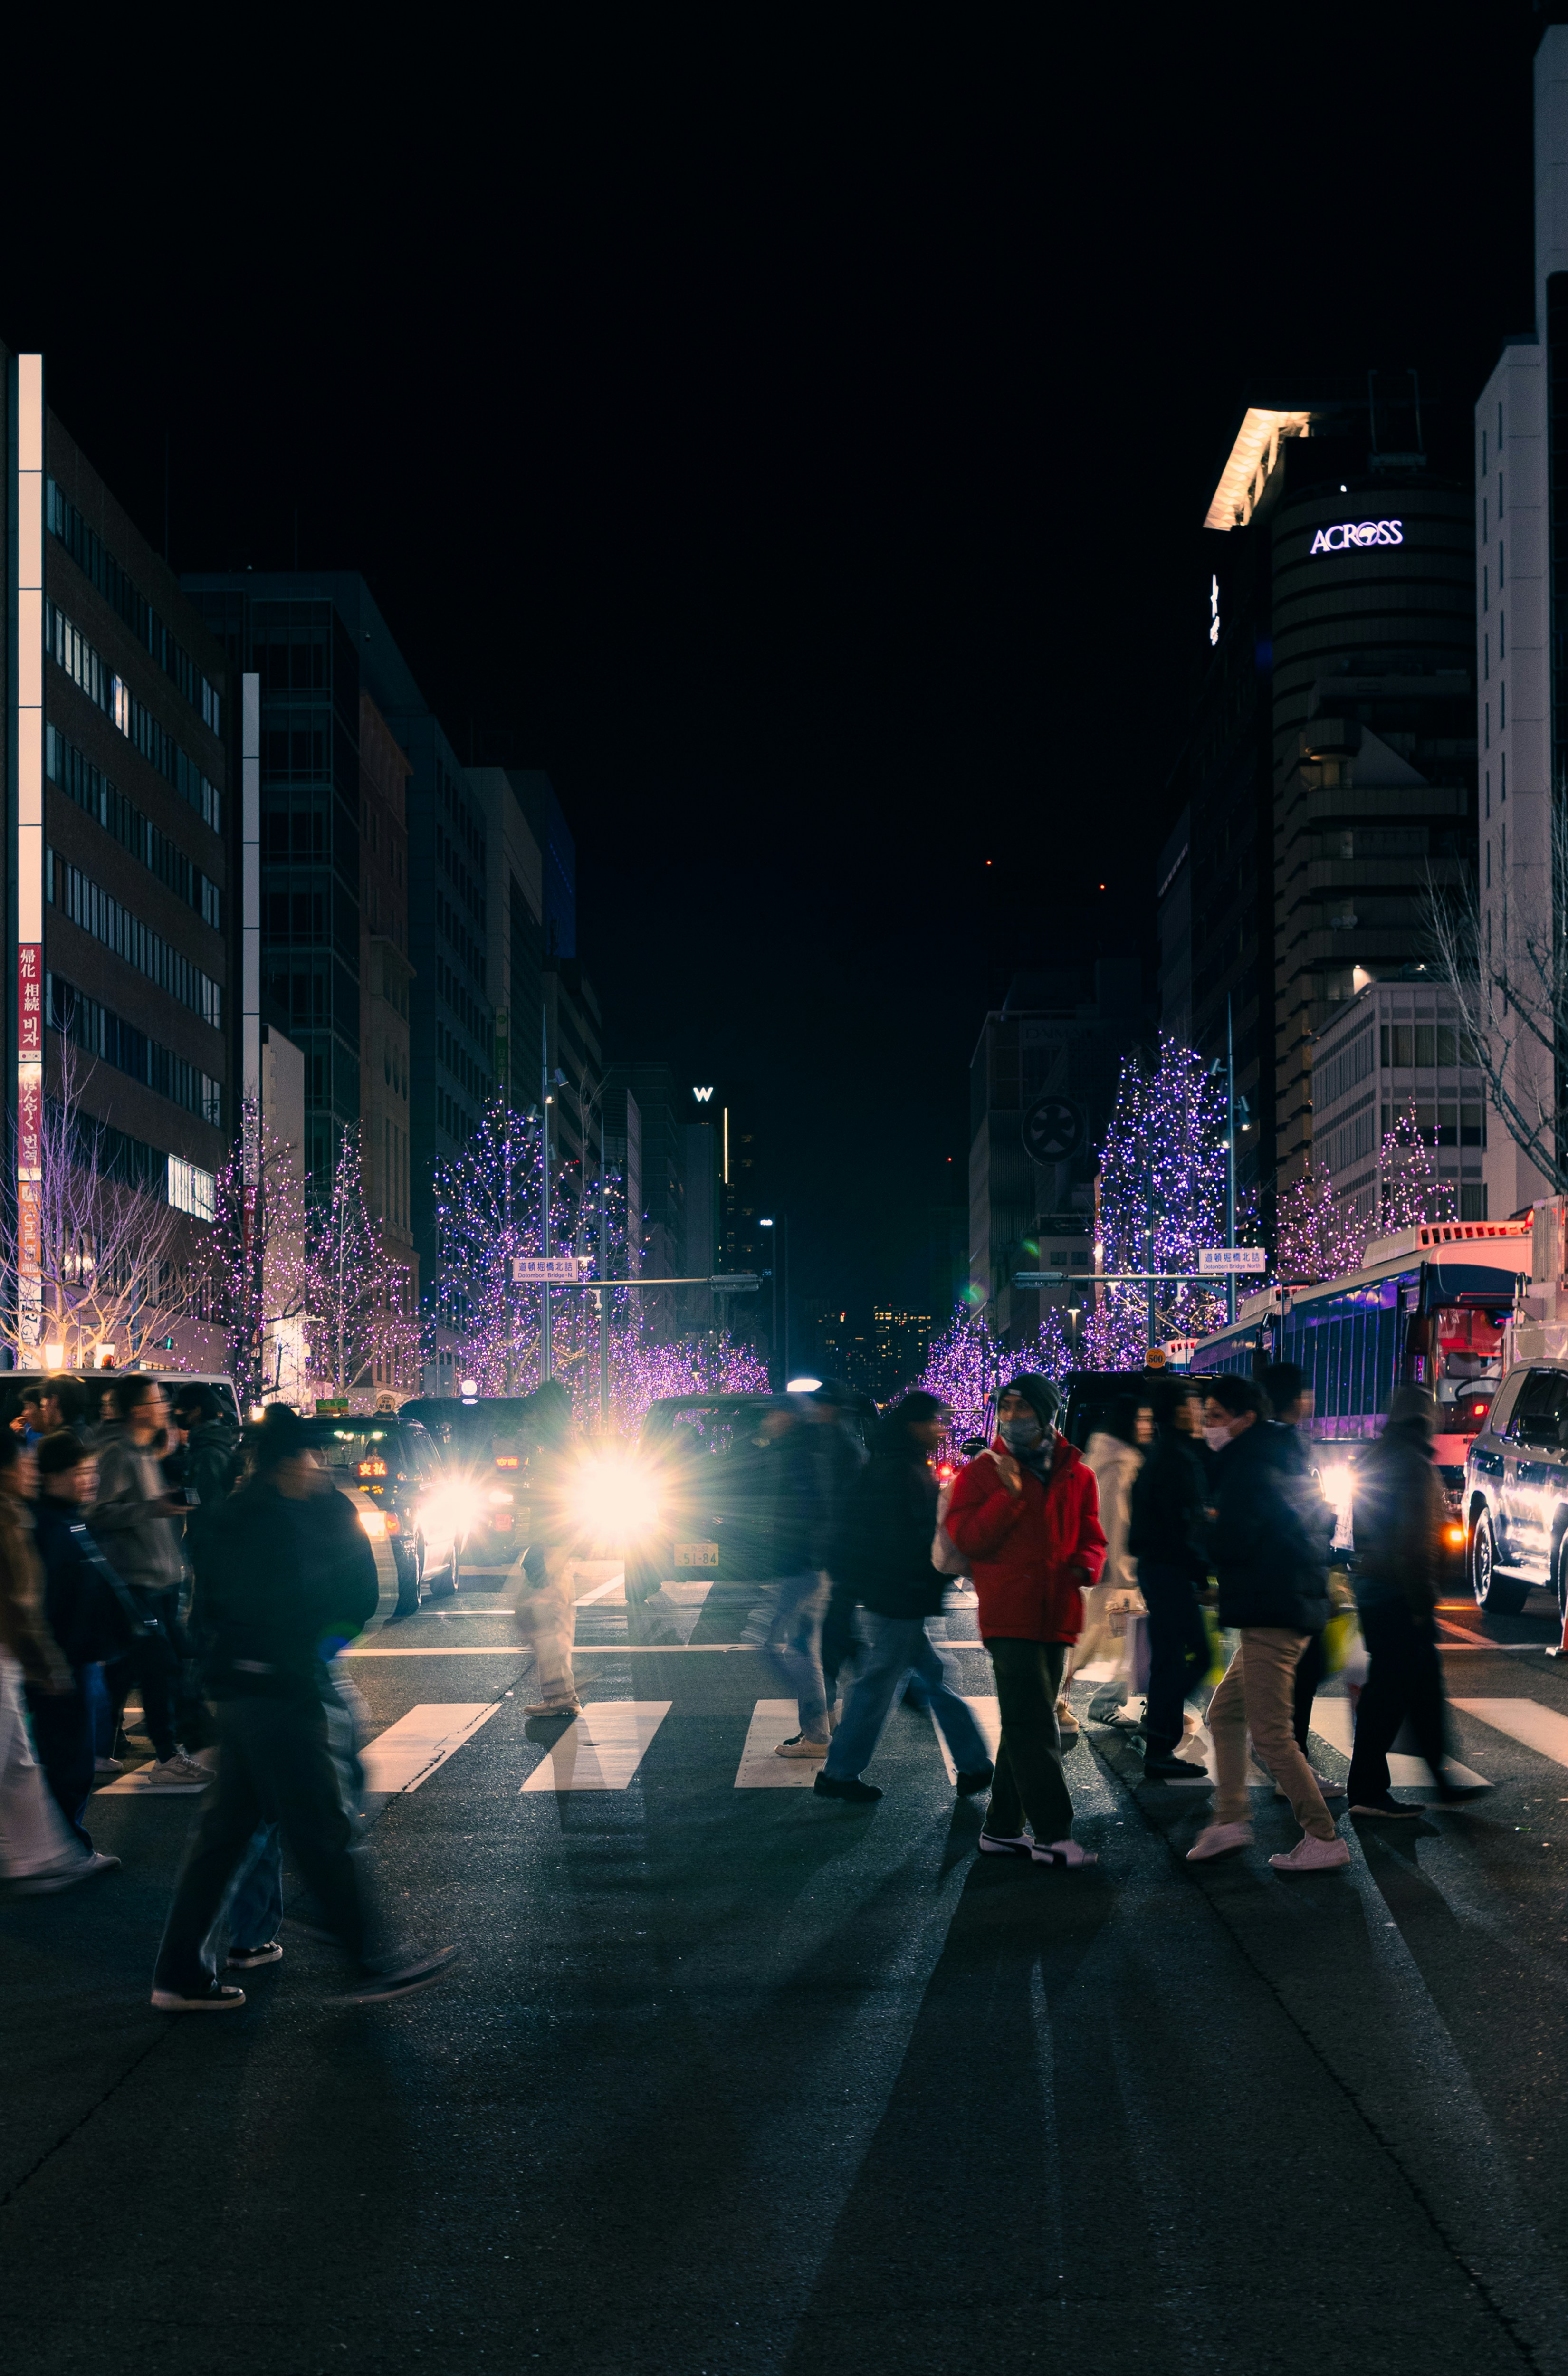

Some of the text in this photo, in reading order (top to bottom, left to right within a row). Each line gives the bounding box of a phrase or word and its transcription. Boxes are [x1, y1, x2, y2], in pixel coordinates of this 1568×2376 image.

[1310, 520, 1403, 554] ACROSS
[20, 949, 39, 1011] 帰化 相続
[23, 1017, 39, 1046] 비자
[693, 1087, 713, 1102] W
[23, 1080, 38, 1130] はんやく
[1205, 1252, 1259, 1262] 道頓堀橋北詰
[519, 1262, 573, 1271] 道頓堀橋北詰
[1149, 1355, 1163, 1363] 500
[359, 1462, 386, 1475] 支払
[684, 1553, 717, 1565] 51-84
